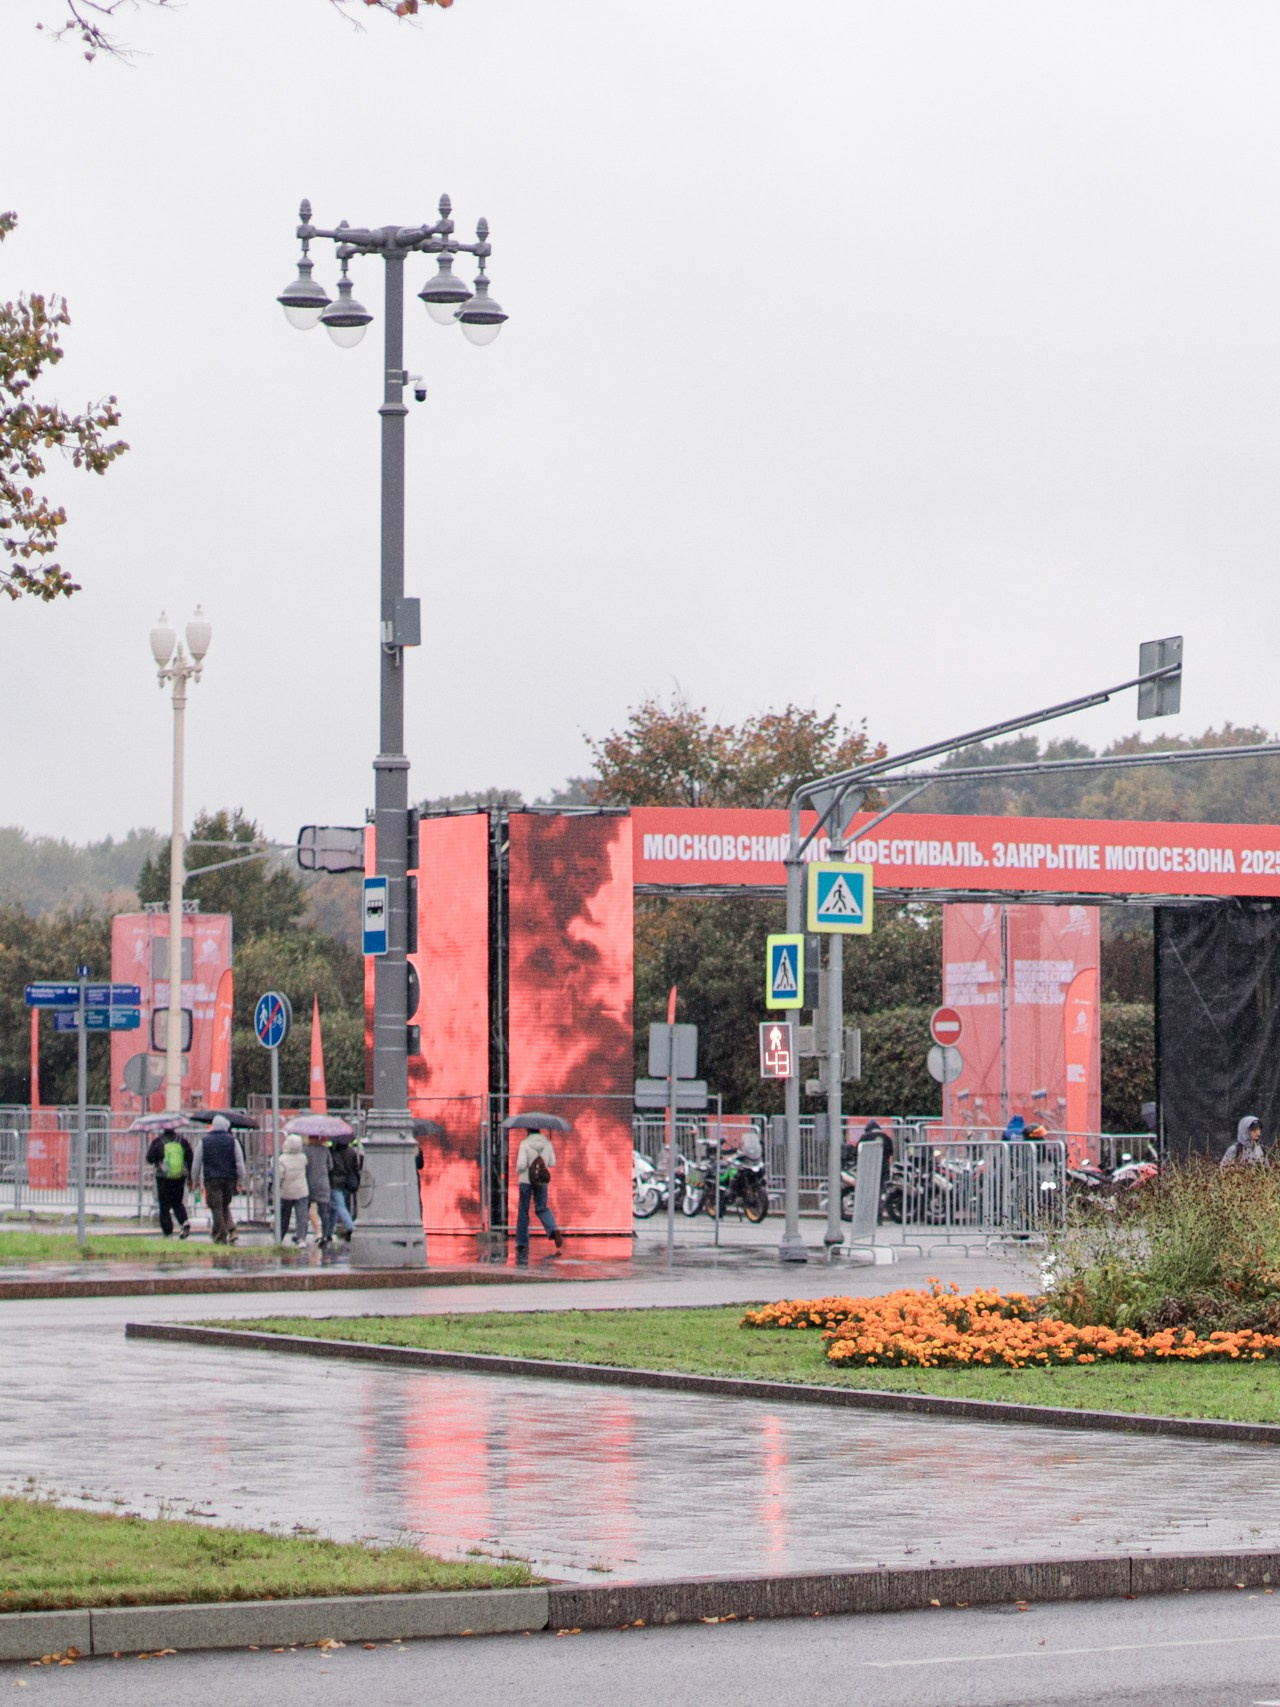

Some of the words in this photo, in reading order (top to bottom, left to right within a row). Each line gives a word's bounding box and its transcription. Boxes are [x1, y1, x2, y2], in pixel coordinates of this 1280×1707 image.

[643, 832, 791, 862] МОСКОВСКИЙ
[798, 836, 989, 867] МООФЕСТИВАЛЬ.
[992, 842, 1100, 870] ЗАКРЫТИЕ
[1105, 844, 1236, 873] МОТОСЕЗОНА
[765, 1051, 790, 1075] 43
